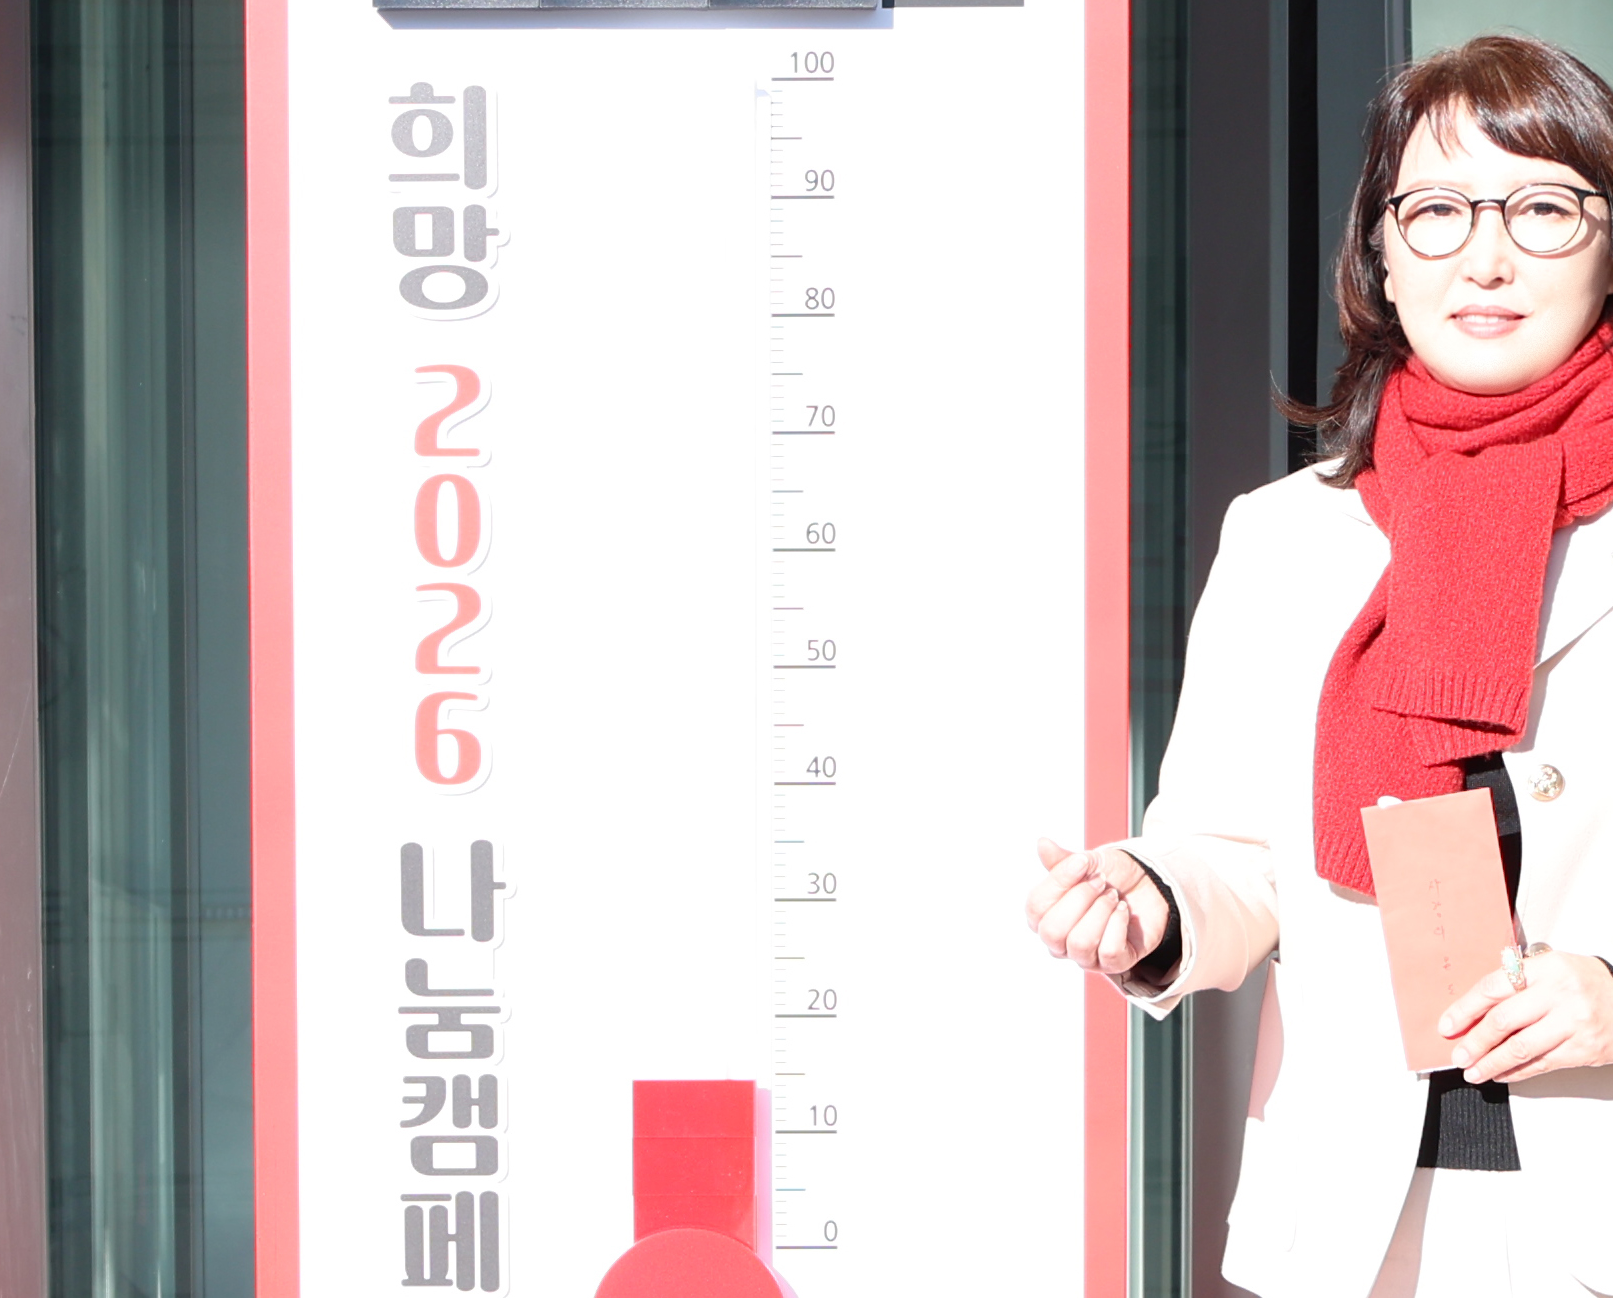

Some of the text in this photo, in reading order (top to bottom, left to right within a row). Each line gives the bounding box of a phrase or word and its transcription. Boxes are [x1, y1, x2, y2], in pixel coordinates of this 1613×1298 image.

[789, 51, 836, 75] 100
[803, 169, 836, 193] 90
[388, 81, 500, 311] 희망
[803, 287, 836, 311] 80
[804, 405, 837, 429] 70
[805, 522, 837, 546] 60
[413, 364, 483, 786] 2026
[806, 639, 837, 663] 50
[805, 756, 838, 780] 40
[806, 873, 838, 895] 30
[806, 989, 838, 1011] 20
[809, 1105, 839, 1128] 10
[822, 1221, 839, 1243] 0
